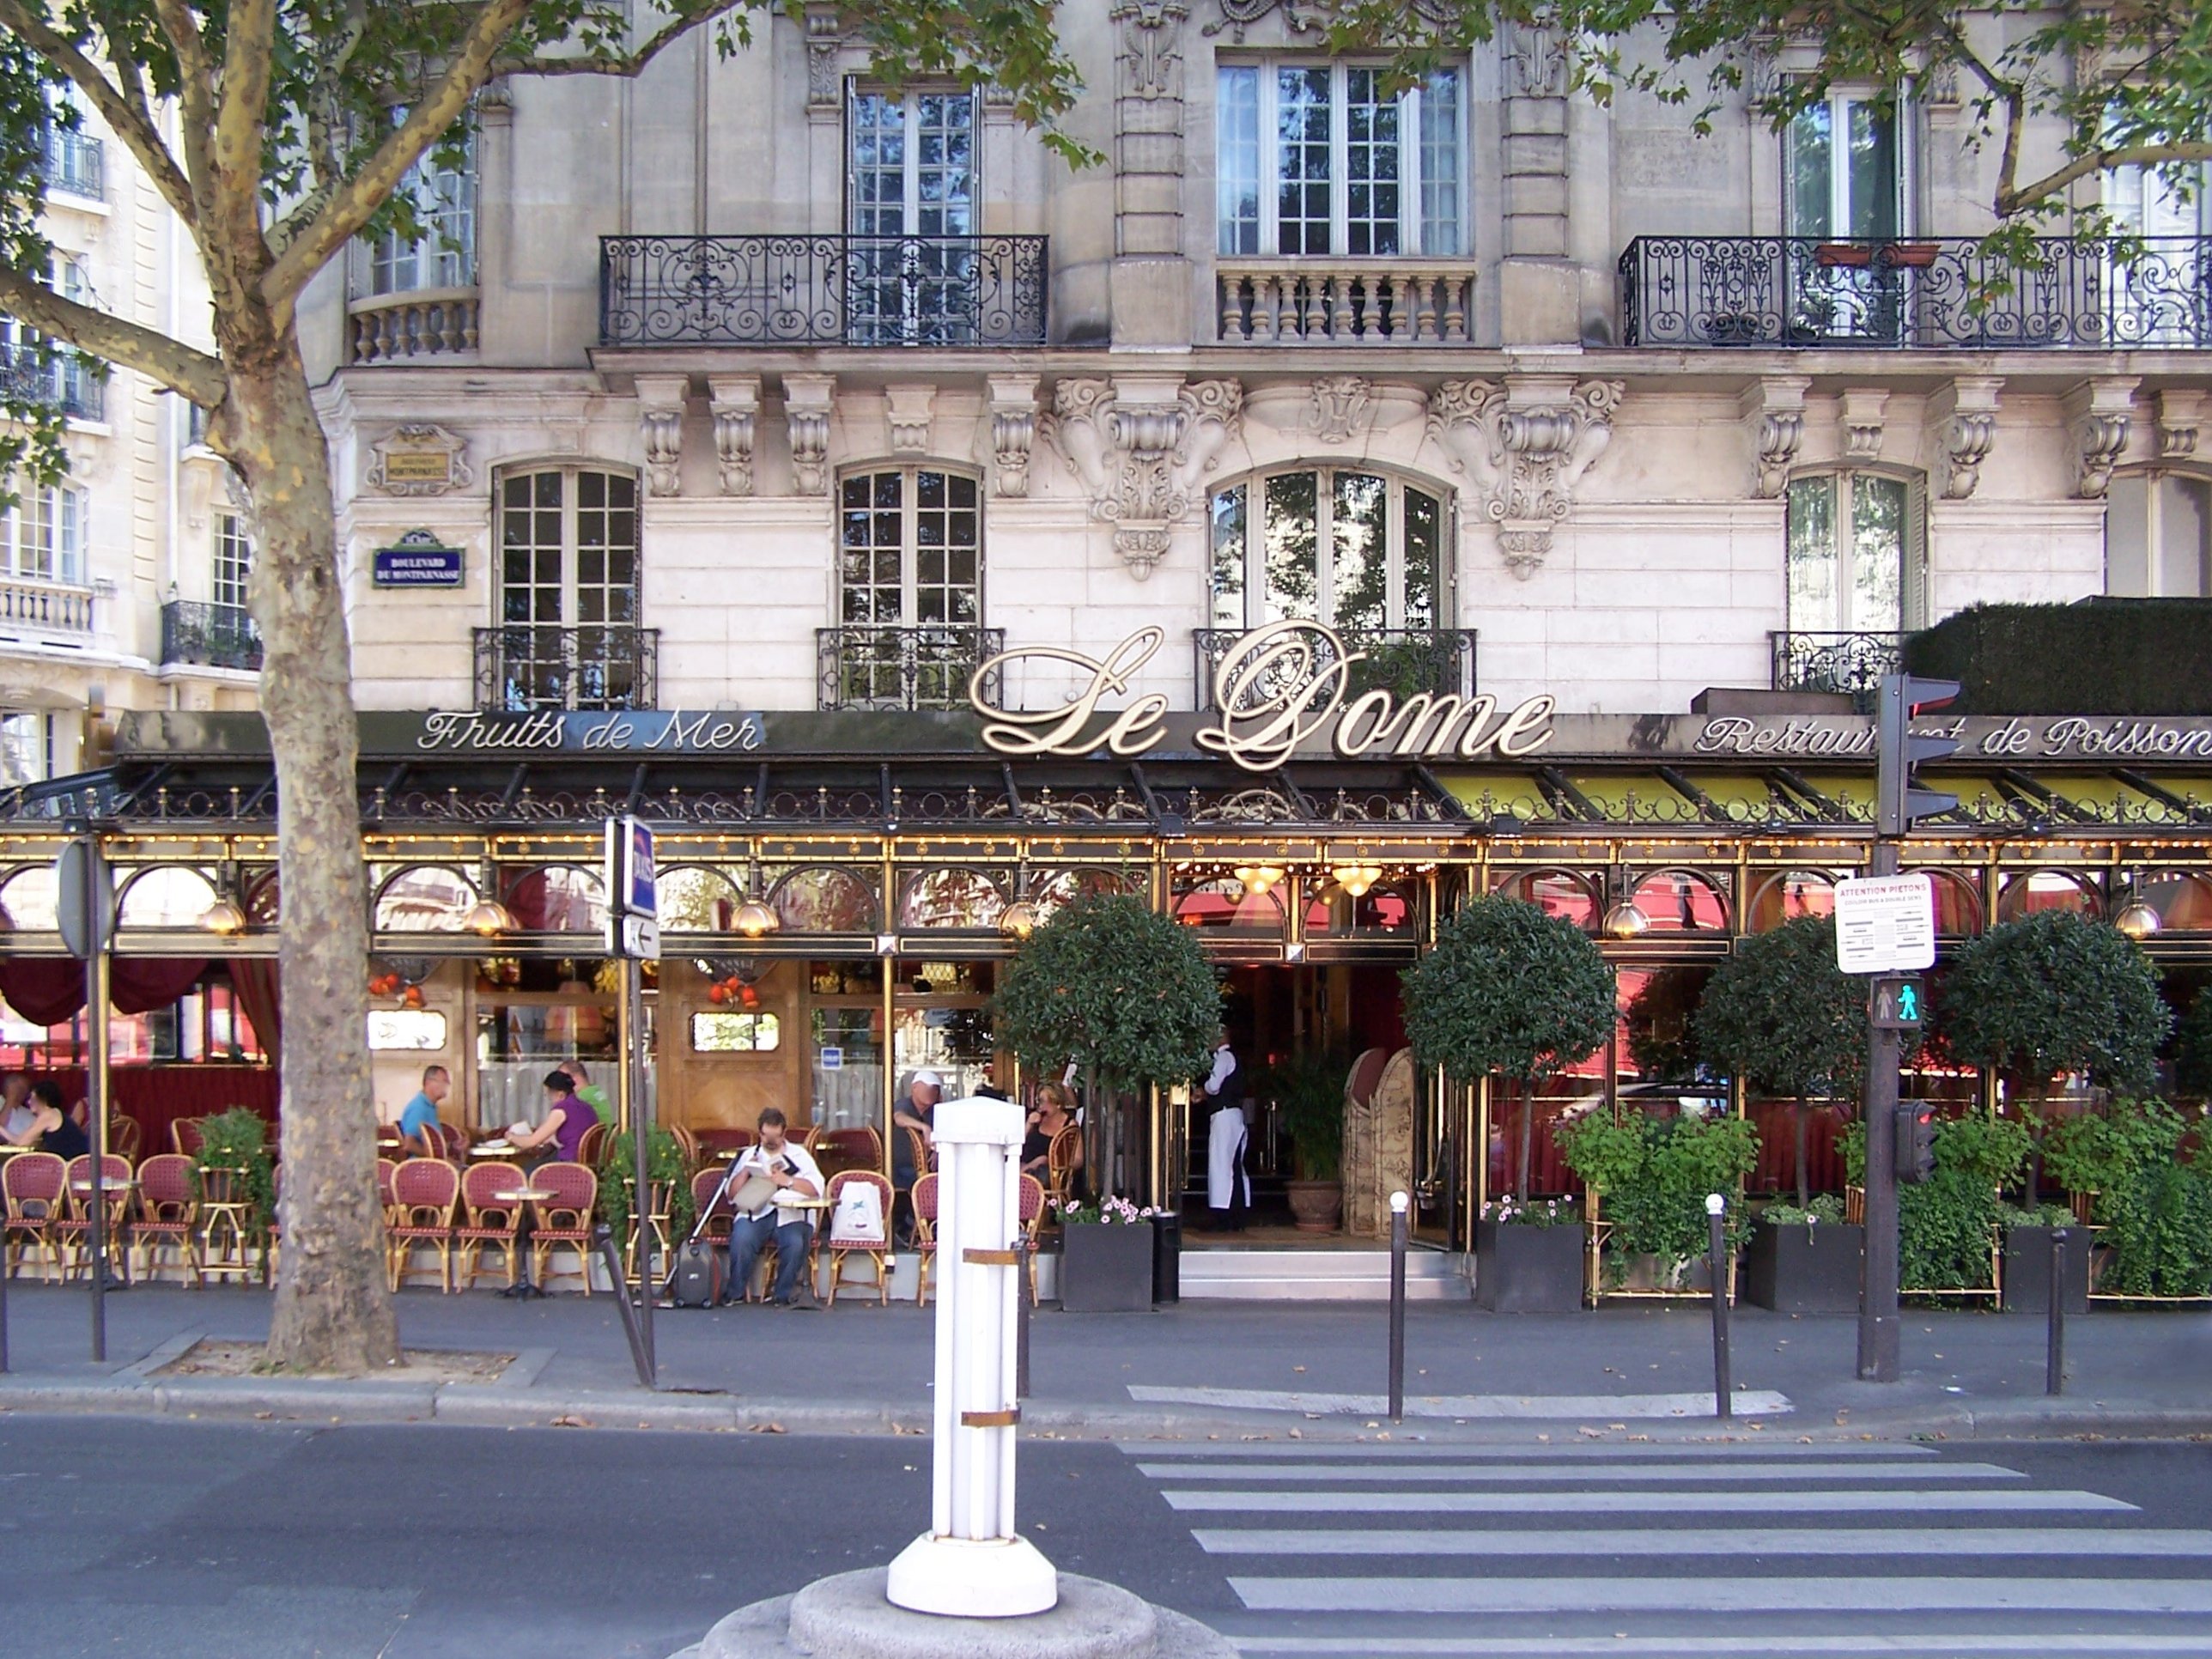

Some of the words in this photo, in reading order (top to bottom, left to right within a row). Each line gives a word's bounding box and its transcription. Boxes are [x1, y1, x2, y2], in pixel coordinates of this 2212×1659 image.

[377, 570, 389, 580] DU
[392, 570, 459, 580] MONTPARNASSE
[391, 558, 447, 568] BOULEVARD
[969, 625, 1168, 756] Le
[1194, 618, 1556, 772] Dome
[417, 710, 567, 750] Fruits
[582, 712, 634, 750] de
[643, 704, 759, 750] Mer
[1983, 716, 2029, 754] de
[1840, 886, 1887, 896] ATTENTION
